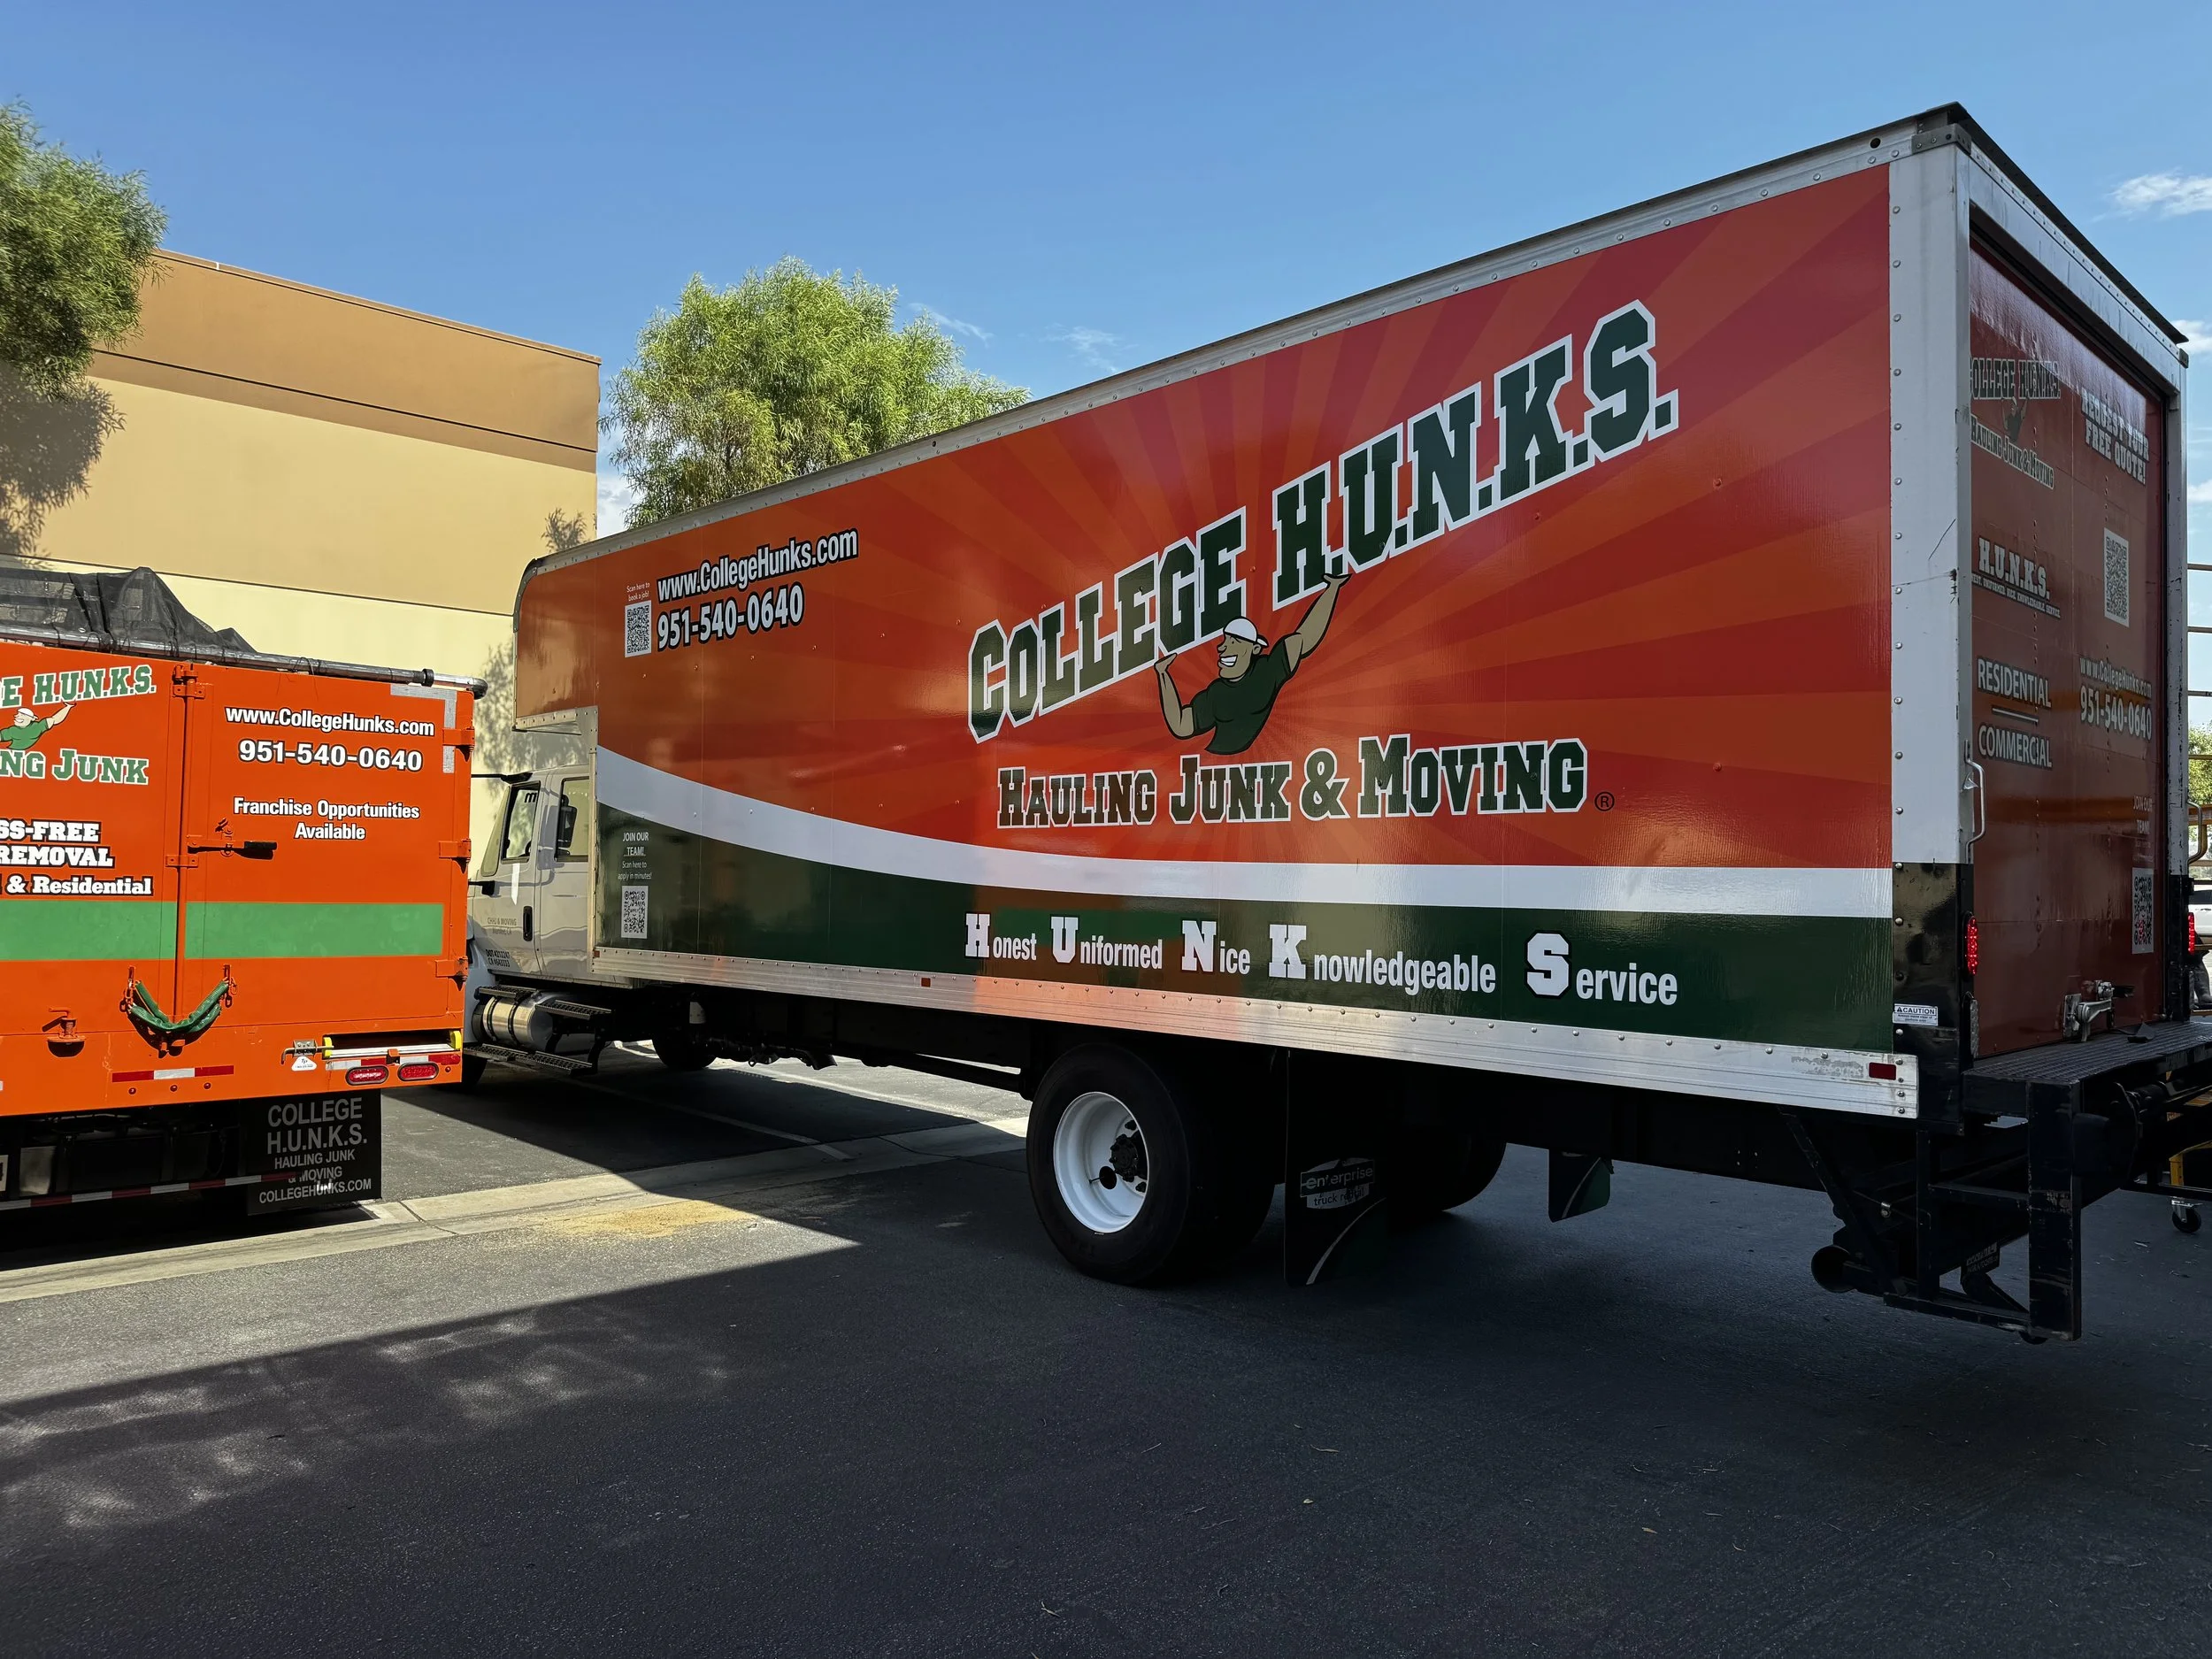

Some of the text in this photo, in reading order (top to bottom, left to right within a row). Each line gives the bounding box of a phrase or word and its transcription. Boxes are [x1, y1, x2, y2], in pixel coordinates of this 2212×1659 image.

[2081, 388, 2124, 442] REQUEST
[2002, 435, 2023, 472] JUNK
[2085, 418, 2147, 485] FREE QUOTE!
[968, 299, 1679, 744] COLLEGE H.U.N.K.S.
[657, 529, 857, 603] www.CollegeHunks.com
[1978, 536, 2050, 601] H.U.N.K.S.
[628, 593, 638, 602] book
[657, 583, 803, 651] 951-540-0640
[33, 664, 157, 705] H.U.N.K.S.
[1977, 658, 2052, 709] RESIDENTIAL
[2079, 657, 2152, 699] www.CollegeHunks.com
[225, 707, 435, 737] www.CollegeHunks.com
[2080, 685, 2152, 741] 951-540-0640
[237, 739, 423, 772] 951-540-0640
[1978, 725, 2052, 768] COMMERCIAL
[52, 749, 149, 785] JUNK
[997, 766, 1157, 829] HAULING
[1170, 754, 1293, 823] JUNK
[1300, 748, 1350, 821] &
[1358, 733, 1588, 818] MOVING
[233, 797, 420, 821] Franchise Opportunities
[294, 823, 366, 841] Available
[622, 832, 649, 842] JOIN OUR
[626, 846, 644, 856] TEAM!
[5, 873, 153, 895] & Residential
[618, 872, 629, 882] apply
[964, 912, 1678, 1006] Honest Uniformed Nice Knowledgeable Service
[268, 1097, 363, 1127] COLLEGE
[267, 1123, 367, 1154] H.U.N.K.S.
[274, 1148, 356, 1169] HAULING JUNK
[299, 1165, 342, 1183] MOVING
[259, 1178, 372, 1203] COLLEGEHUNKS.COM
[1314, 1194, 1337, 1206] truck
